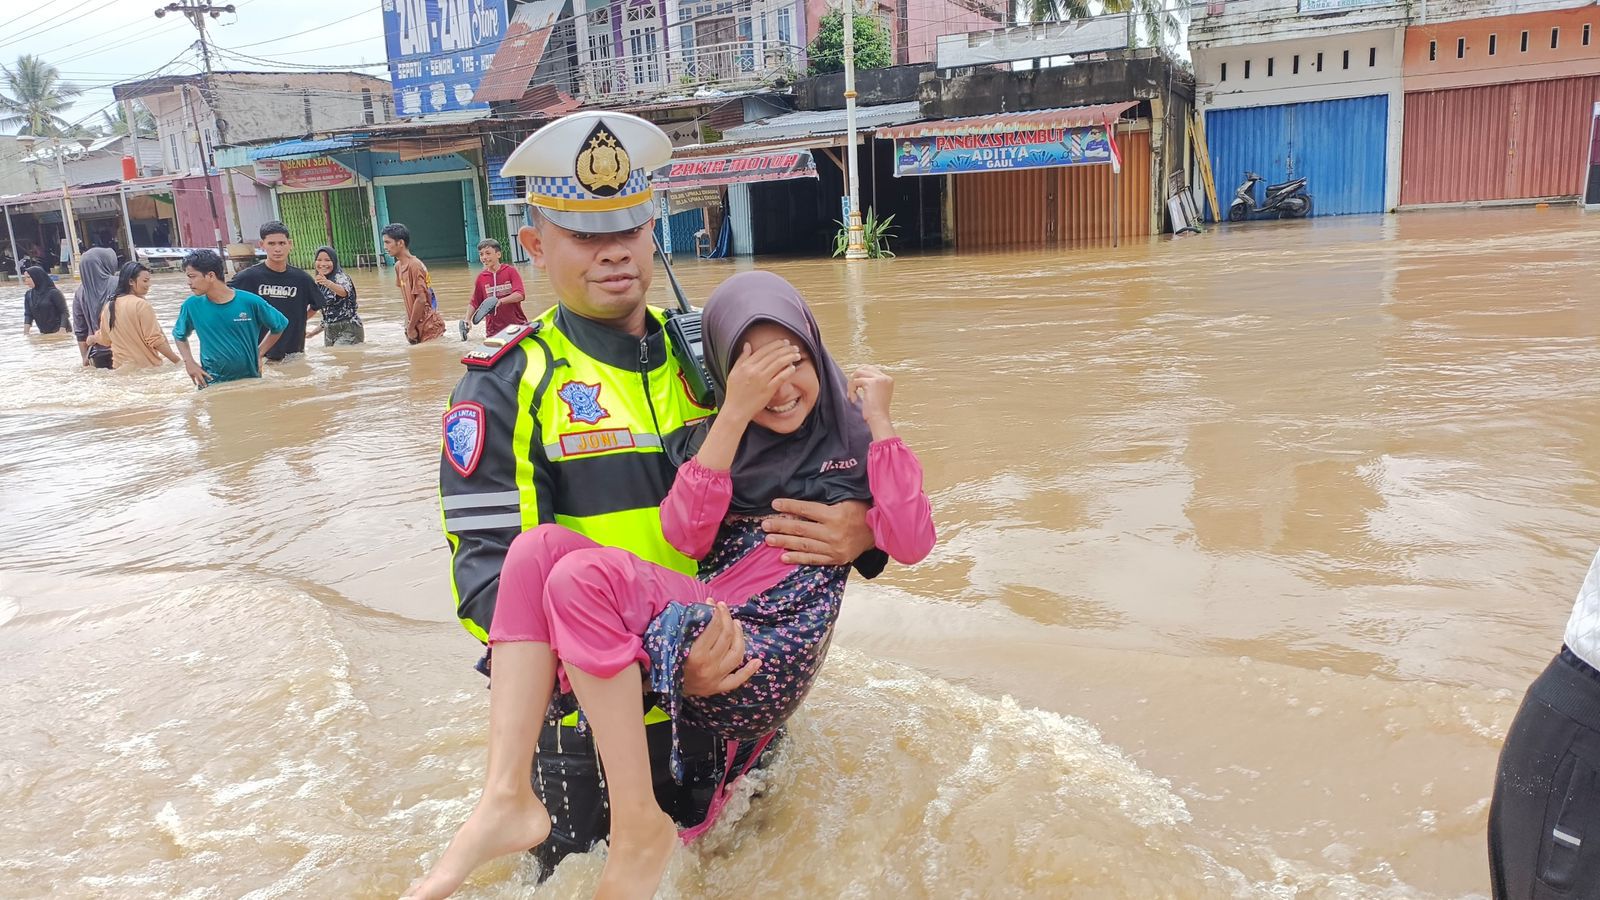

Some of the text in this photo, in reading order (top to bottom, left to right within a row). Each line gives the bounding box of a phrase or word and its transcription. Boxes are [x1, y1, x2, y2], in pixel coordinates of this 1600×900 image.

[396, 0, 431, 55] ZAM
[438, 0, 472, 51] ZAM
[472, 0, 499, 45] Store
[461, 55, 474, 72] TAS
[936, 128, 1065, 151] PANGKAS RAMBUT
[972, 146, 1029, 162] ADITYA
[578, 432, 618, 450] JONI
